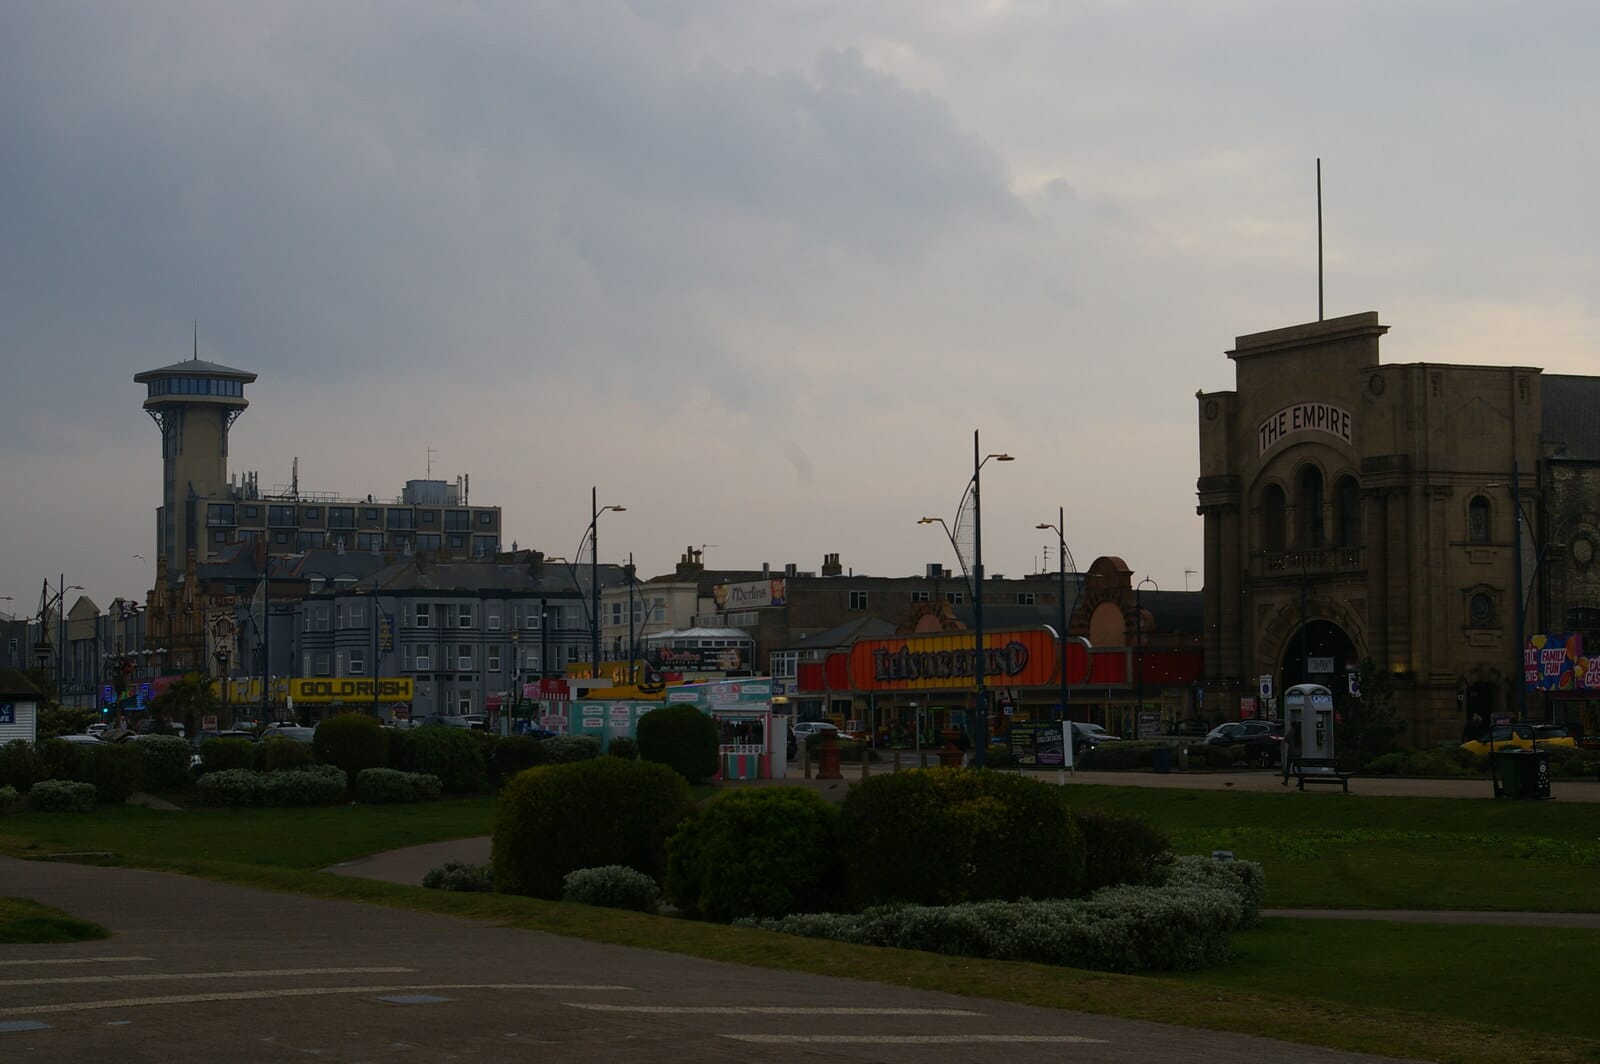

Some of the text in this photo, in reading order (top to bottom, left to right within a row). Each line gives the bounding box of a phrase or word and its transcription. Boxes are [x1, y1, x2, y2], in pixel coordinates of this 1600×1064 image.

[1260, 405, 1350, 449] THE EMPIRE
[1542, 649, 1566, 663] FAMILY
[1545, 662, 1560, 675] FUN
[301, 681, 409, 696] GOLDRUSH
